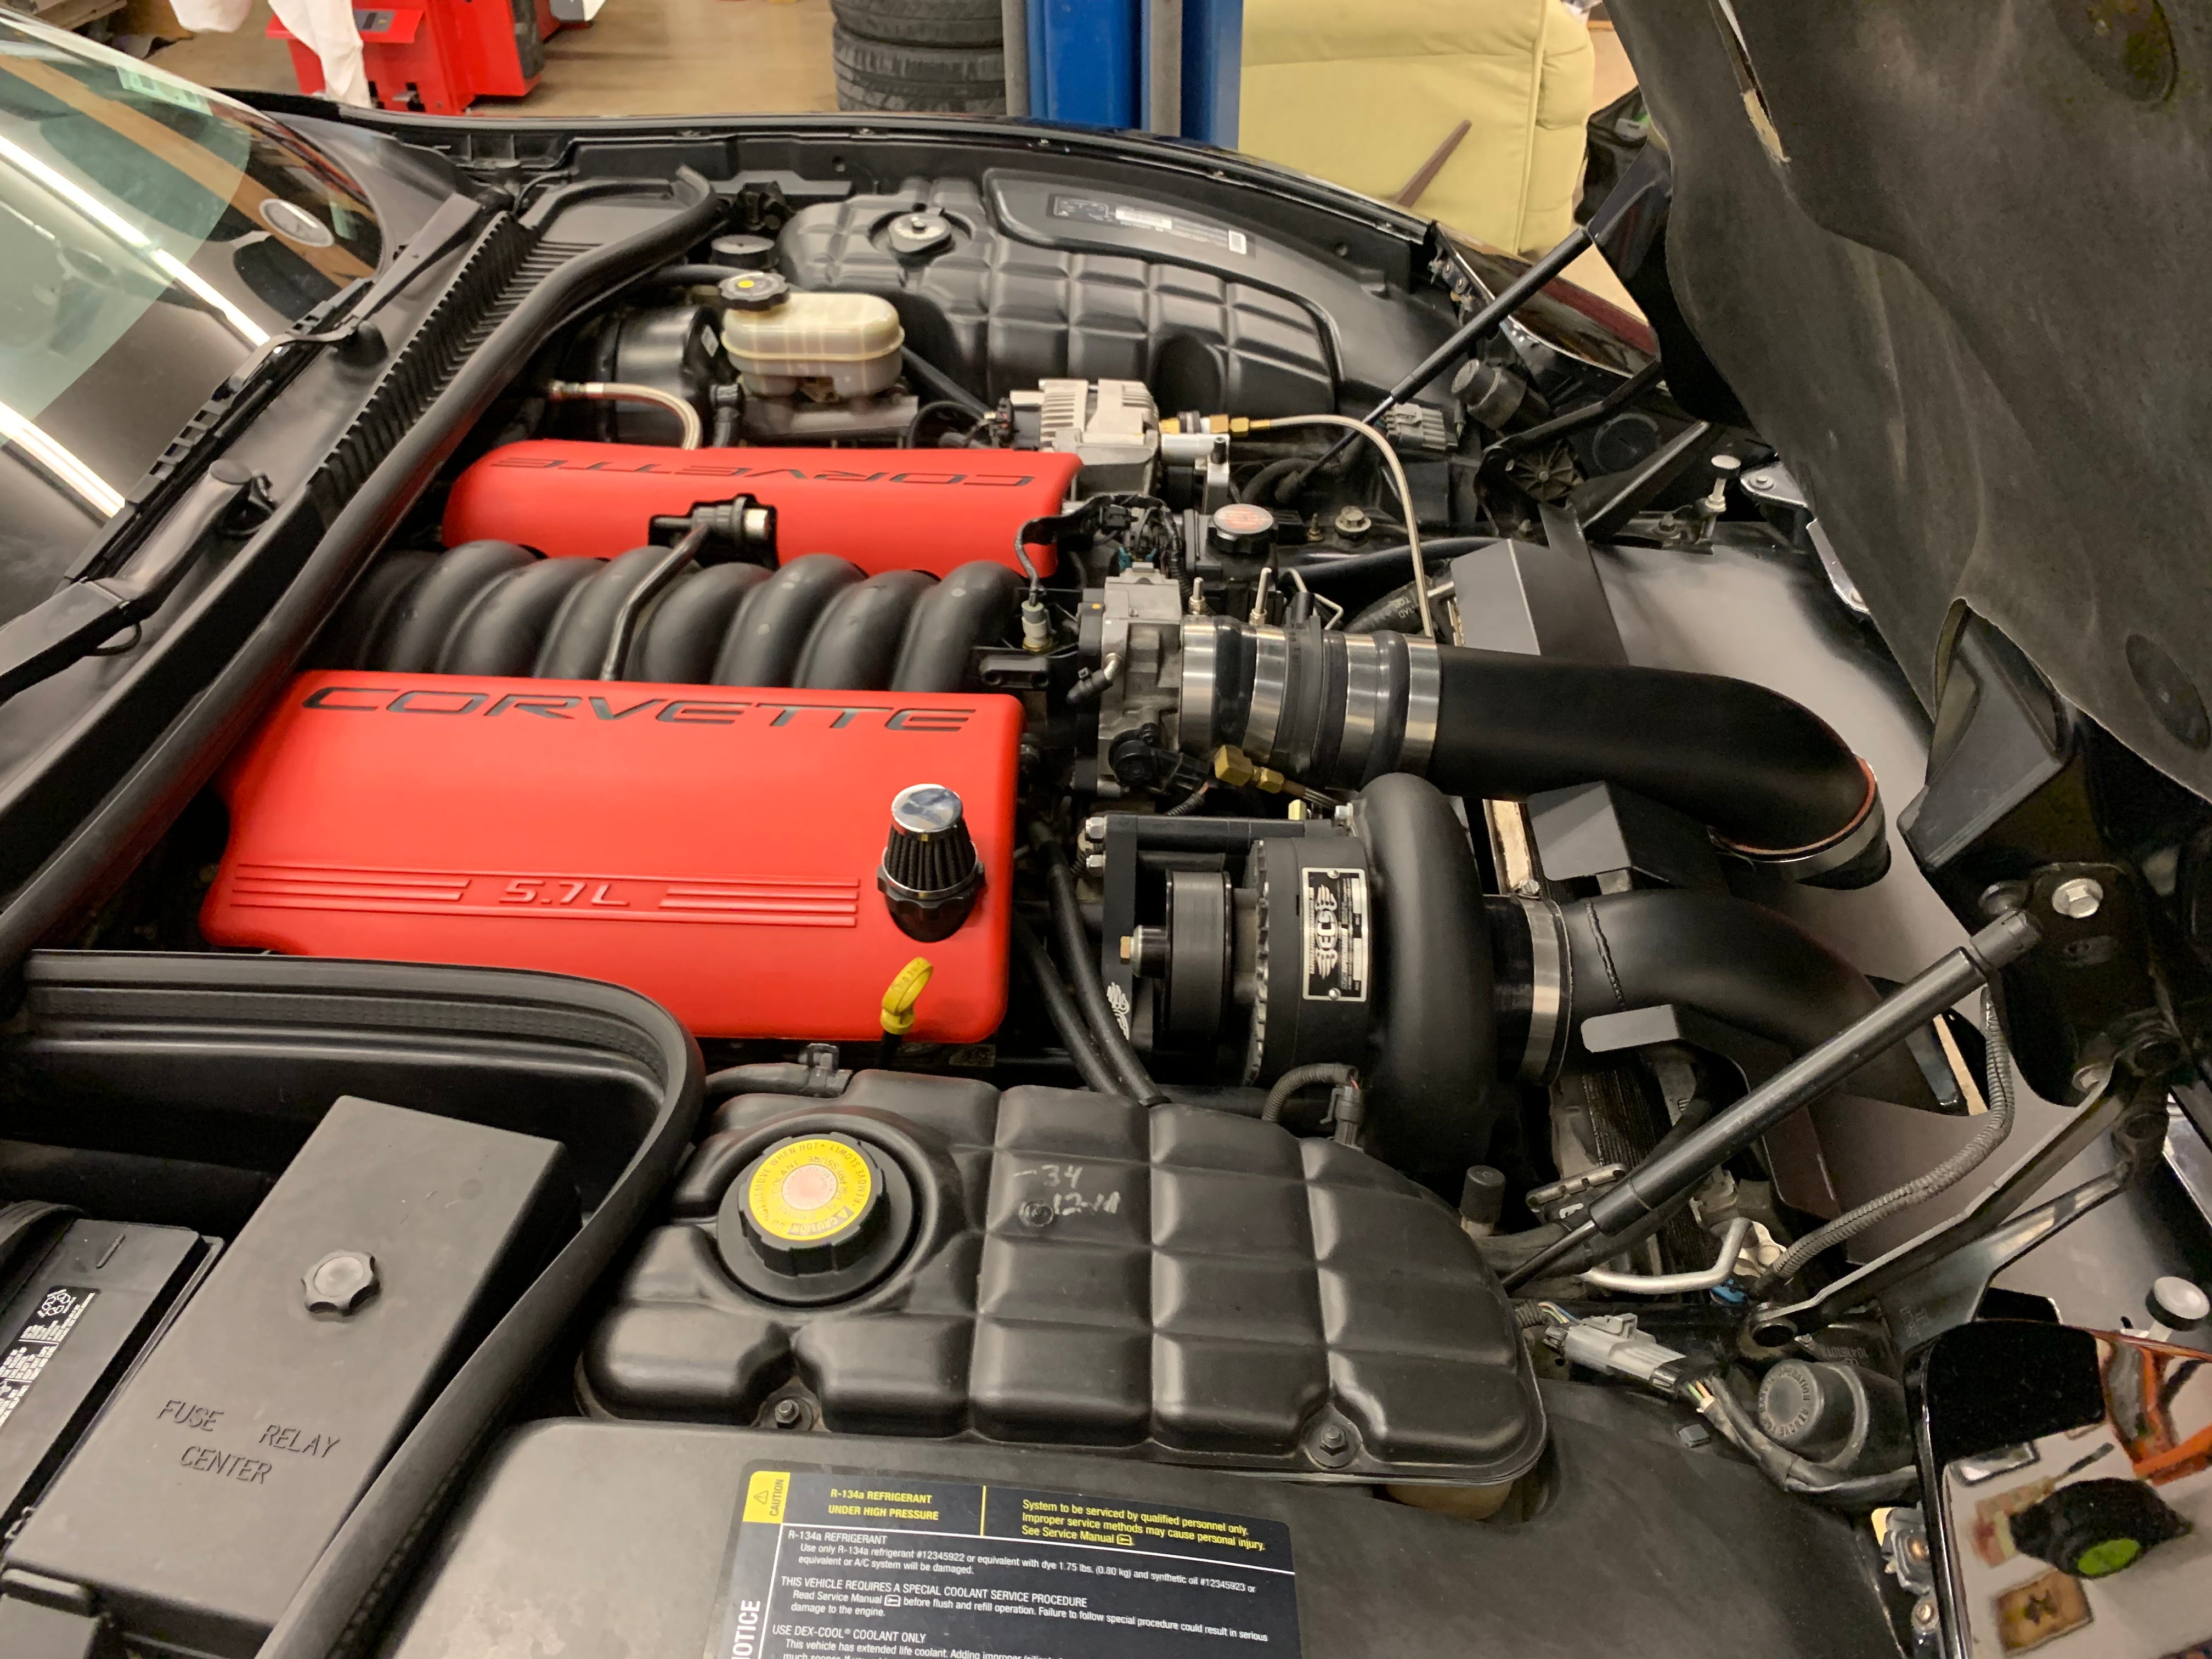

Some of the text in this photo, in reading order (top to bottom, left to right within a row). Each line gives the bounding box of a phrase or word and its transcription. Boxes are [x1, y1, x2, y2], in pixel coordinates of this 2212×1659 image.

[490, 456, 1036, 487] CORVETTE
[303, 685, 977, 732] CORVETTE
[499, 879, 630, 907] 5.7L
[1317, 910, 1336, 949] ECS
[754, 1169, 770, 1201] REMOVE
[769, 1147, 797, 1166] WHEN
[799, 1142, 819, 1151] HOT
[807, 1155, 847, 1186] PRESSURE
[828, 1144, 867, 1204] REMOVE SLOWLY
[791, 1215, 839, 1233] CAUTION
[156, 1398, 341, 1459] FUSE RELAY
[179, 1446, 273, 1485] CENTER
[770, 1479, 784, 1516] CAUTION
[831, 1489, 932, 1504] R-134a REFRIGERANT
[828, 1505, 939, 1521] UNDER HIGH PRESSURE
[1023, 1499, 1249, 1536] System to be serviced by qualified personnel only.
[788, 1530, 888, 1544] R-134a REFRIGERANT
[1022, 1513, 1265, 1551] Improper service methods may cause personal injury.
[1022, 1525, 1114, 1543] See Service Manual
[798, 1556, 974, 1575] equivalent or A/C system will be damaged.
[800, 1544, 816, 1553] Use
[819, 1545, 835, 1555] only
[838, 1545, 868, 1556] R-134a
[871, 1547, 914, 1561] refrigerant
[917, 1550, 964, 1562] #12345922
[978, 1555, 1019, 1566] equivalent
[1022, 1558, 1039, 1568] with
[1041, 1560, 1056, 1570] dye
[1059, 1562, 1076, 1572] 1.75
[1079, 1563, 1093, 1573] lbs.
[1095, 1565, 1116, 1576] (0.80
[1119, 1567, 1131, 1579] kg)
[1134, 1570, 1148, 1579] and
[1151, 1573, 1186, 1584] synthetic
[1189, 1576, 1198, 1585] oil
[1200, 1578, 1245, 1592] #12345923
[1248, 1585, 1256, 1593] or
[782, 1576, 1087, 1608] THIS VEHICLE REQUIRES A SPECIAL COOLANT SERVICE PROCEDURE
[791, 1602, 886, 1617] damage to the engine.
[793, 1590, 1268, 1641] Read Service Manual before flush and refill operation. Failure to follow special procedure could result in serious
[731, 1599, 761, 1659] OTICE
[772, 1624, 792, 1635] USE
[853, 1629, 899, 1641] COOLANT
[901, 1632, 926, 1644] ONLY
[786, 1639, 803, 1649] This
[806, 1640, 836, 1651] vehicle
[839, 1643, 854, 1652] has
[857, 1644, 895, 1655] extended
[899, 1645, 912, 1656] life
[915, 1647, 948, 1658] coolant.
[950, 1649, 980, 1659] Adding
